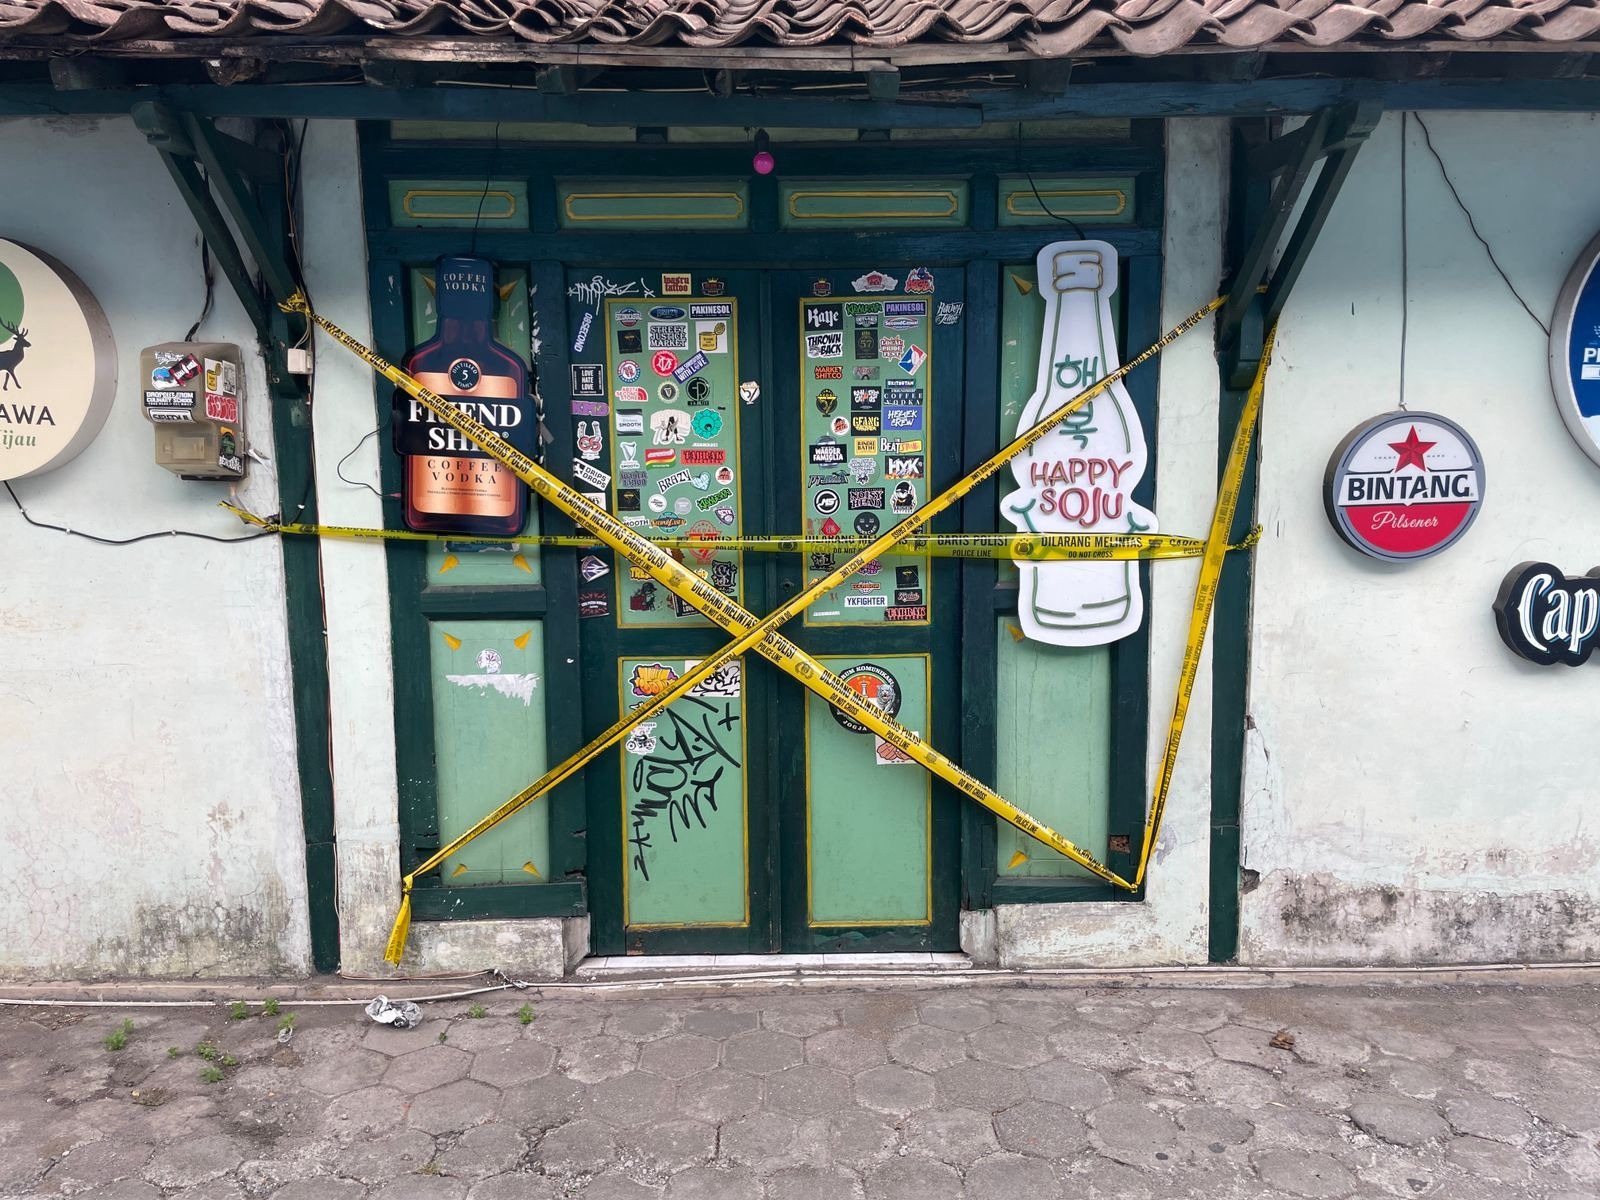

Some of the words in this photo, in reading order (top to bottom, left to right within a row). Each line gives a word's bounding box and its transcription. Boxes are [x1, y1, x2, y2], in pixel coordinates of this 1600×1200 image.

[443, 273, 487, 284] COFFEE
[445, 282, 486, 293] VODKA
[692, 304, 730, 314] PAKINESOL
[886, 303, 924, 312] PAKINESOL
[574, 312, 593, 352] OBSECOND
[650, 324, 686, 333] STREET
[650, 332, 687, 341] JUSTICE
[808, 334, 842, 346] THROWN
[650, 340, 686, 348] MARKET
[820, 344, 841, 355] BACK
[462, 370, 469, 381] 5
[582, 376, 594, 384] HATE
[0, 429, 37, 450] ijau
[428, 459, 502, 472] COFFEE
[432, 472, 497, 484] VODKA
[585, 467, 606, 482] DRIPS
[1030, 458, 1134, 488] HAPPY
[582, 472, 606, 488] DROPS
[1348, 474, 1470, 501] BINTANG
[1040, 487, 1124, 528] SOJU
[1371, 511, 1439, 530] Pilsener
[938, 534, 969, 546] GARIS
[973, 534, 1008, 546] POLISI
[1041, 536, 1091, 548] DILARANG
[1094, 536, 1143, 548] MELINTAS
[1092, 550, 1113, 558] CROSS
[691, 581, 724, 609] DILARANG
[846, 597, 886, 606] YKFIGHTER
[1517, 573, 1600, 654] Cap
[757, 642, 774, 657] POLICE
[774, 636, 798, 659] POLISI
[820, 670, 852, 697] DILARANG
[850, 692, 882, 720] MELINTAS
[882, 712, 902, 732] GARIS
[844, 702, 860, 716] CROSS
[842, 720, 868, 732] JOGJA
[886, 730, 901, 745] POLICE
[972, 788, 987, 801] CROSS
[1014, 814, 1029, 829] POLICE
